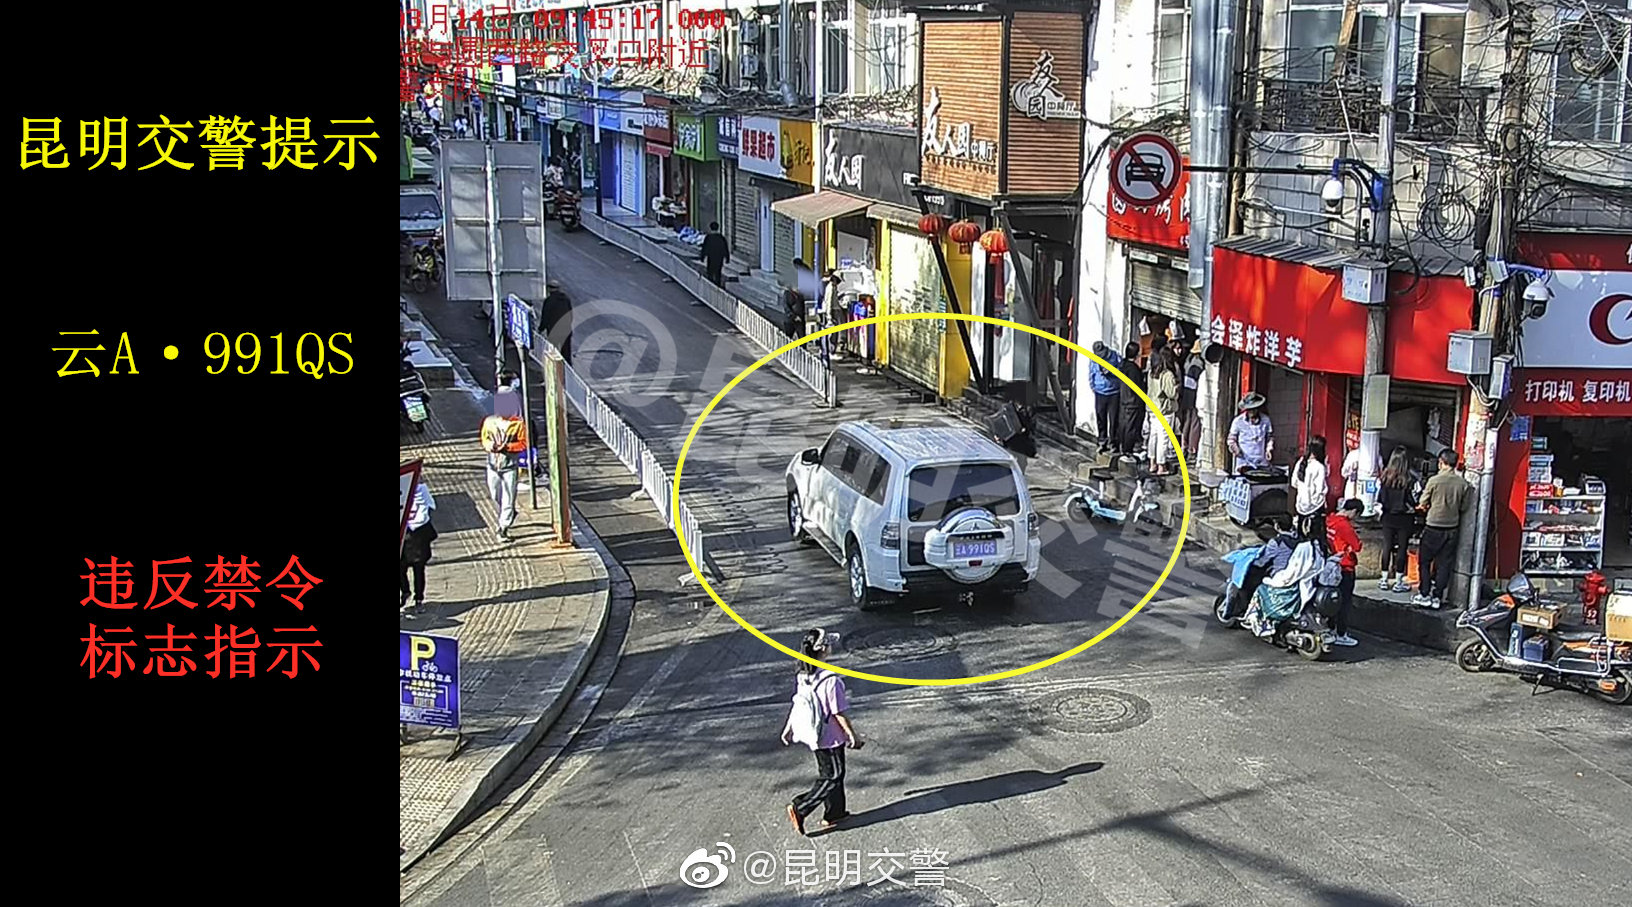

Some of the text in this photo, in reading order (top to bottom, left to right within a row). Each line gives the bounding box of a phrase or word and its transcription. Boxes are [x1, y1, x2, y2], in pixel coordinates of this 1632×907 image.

[1211, 315, 1303, 368] 会泽炸洋芋
[1525, 379, 1632, 403] 打印机 复印机
[410, 635, 436, 671] P
